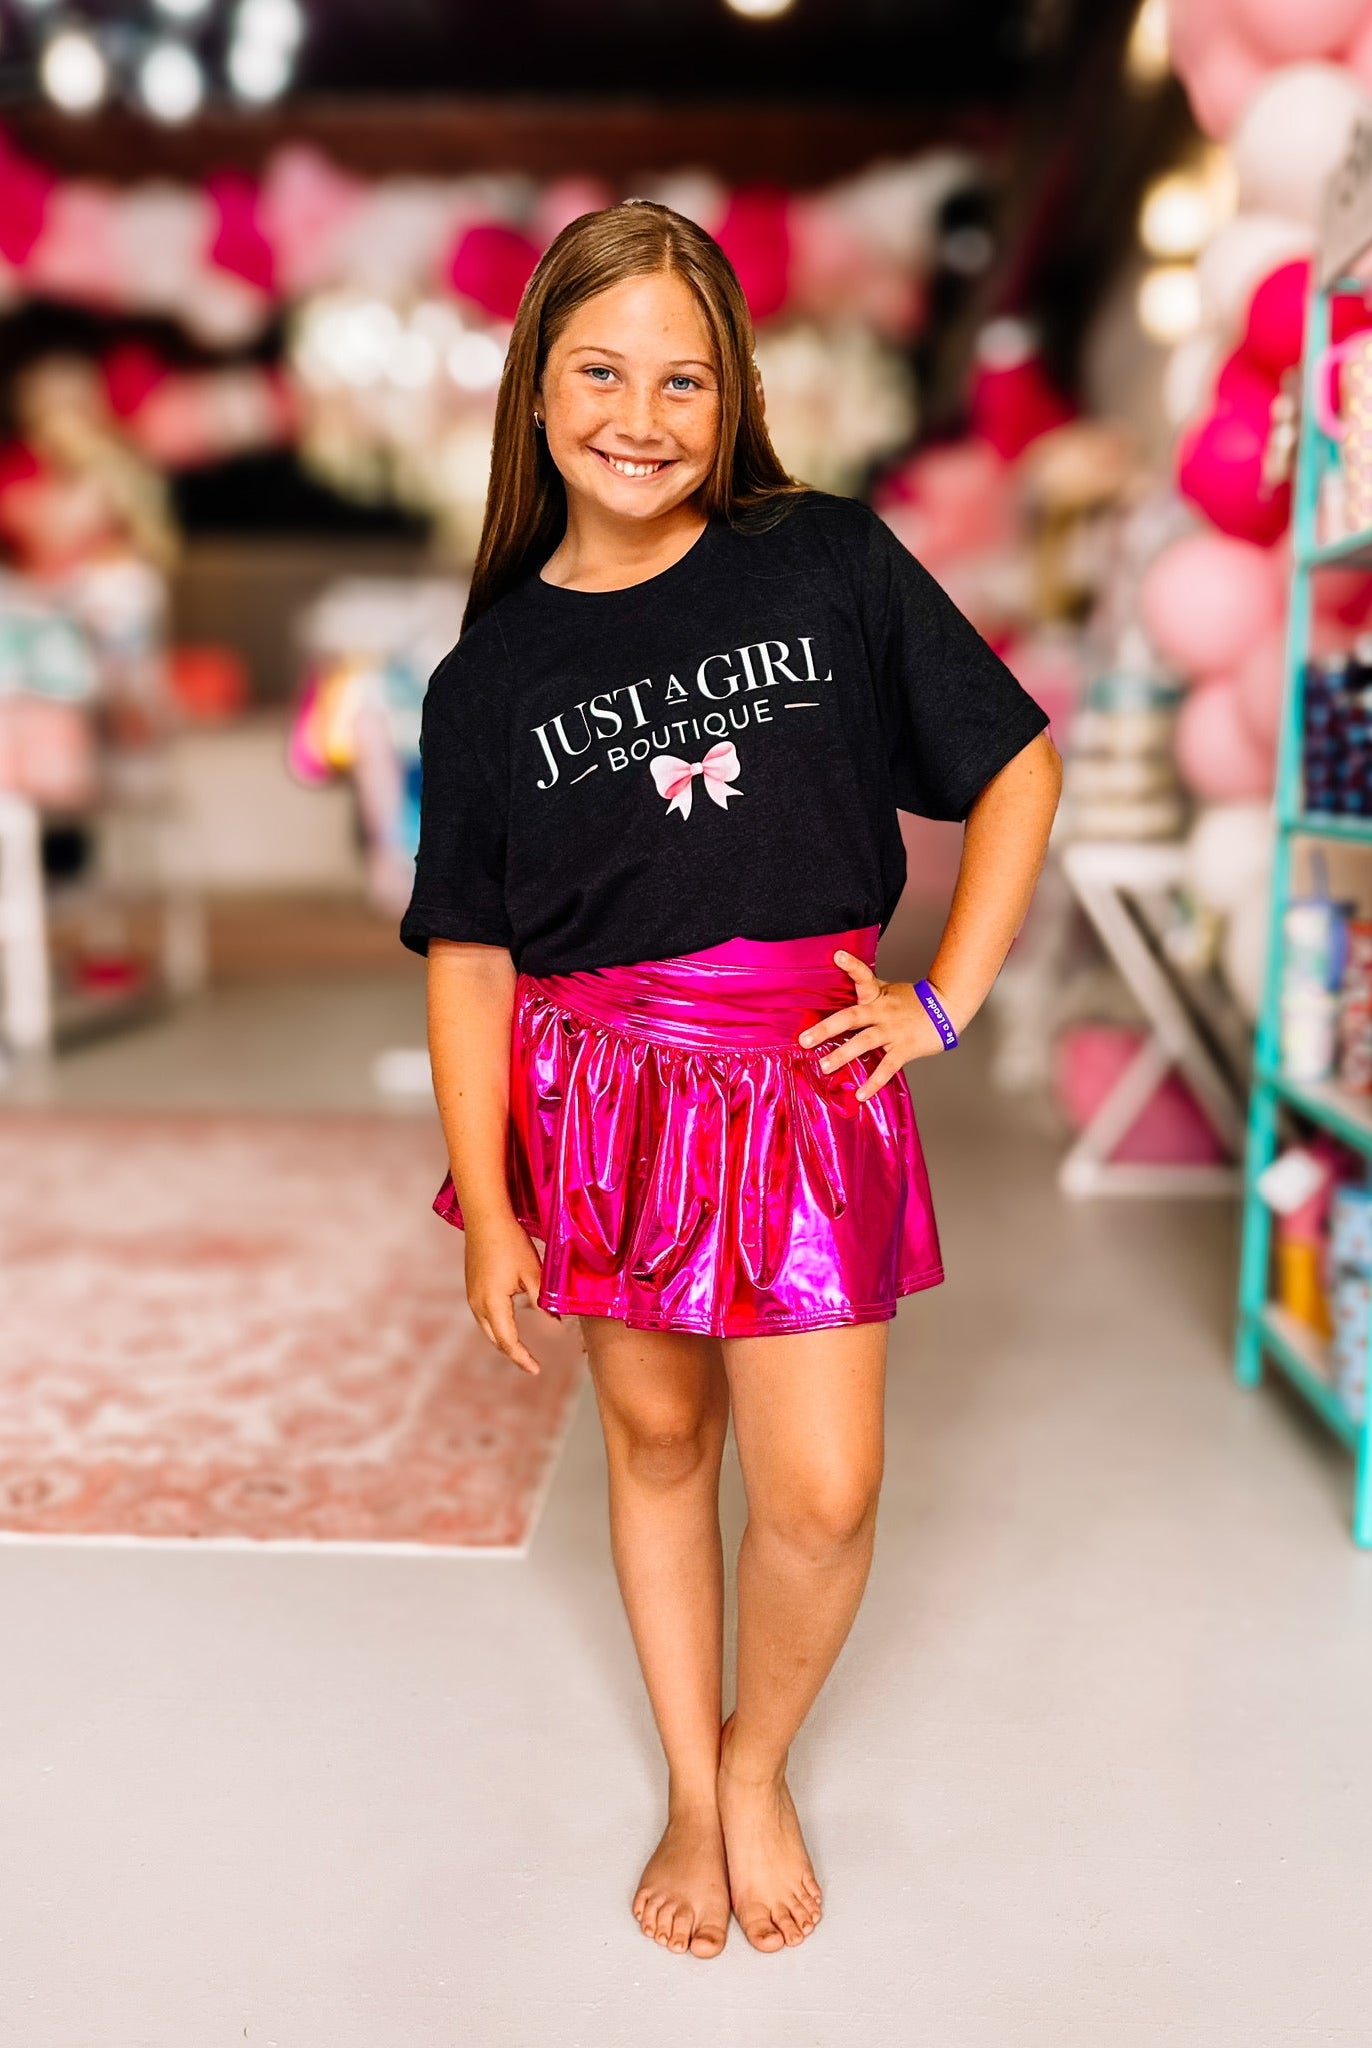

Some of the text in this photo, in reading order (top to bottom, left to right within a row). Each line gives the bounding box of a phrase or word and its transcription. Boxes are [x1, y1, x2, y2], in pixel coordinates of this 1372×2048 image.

[530, 637, 833, 790] JUST A GIRL
[607, 698, 773, 772] BOUTIQUE
[925, 996, 946, 1025] Leader
[946, 1031, 956, 1045] Be
